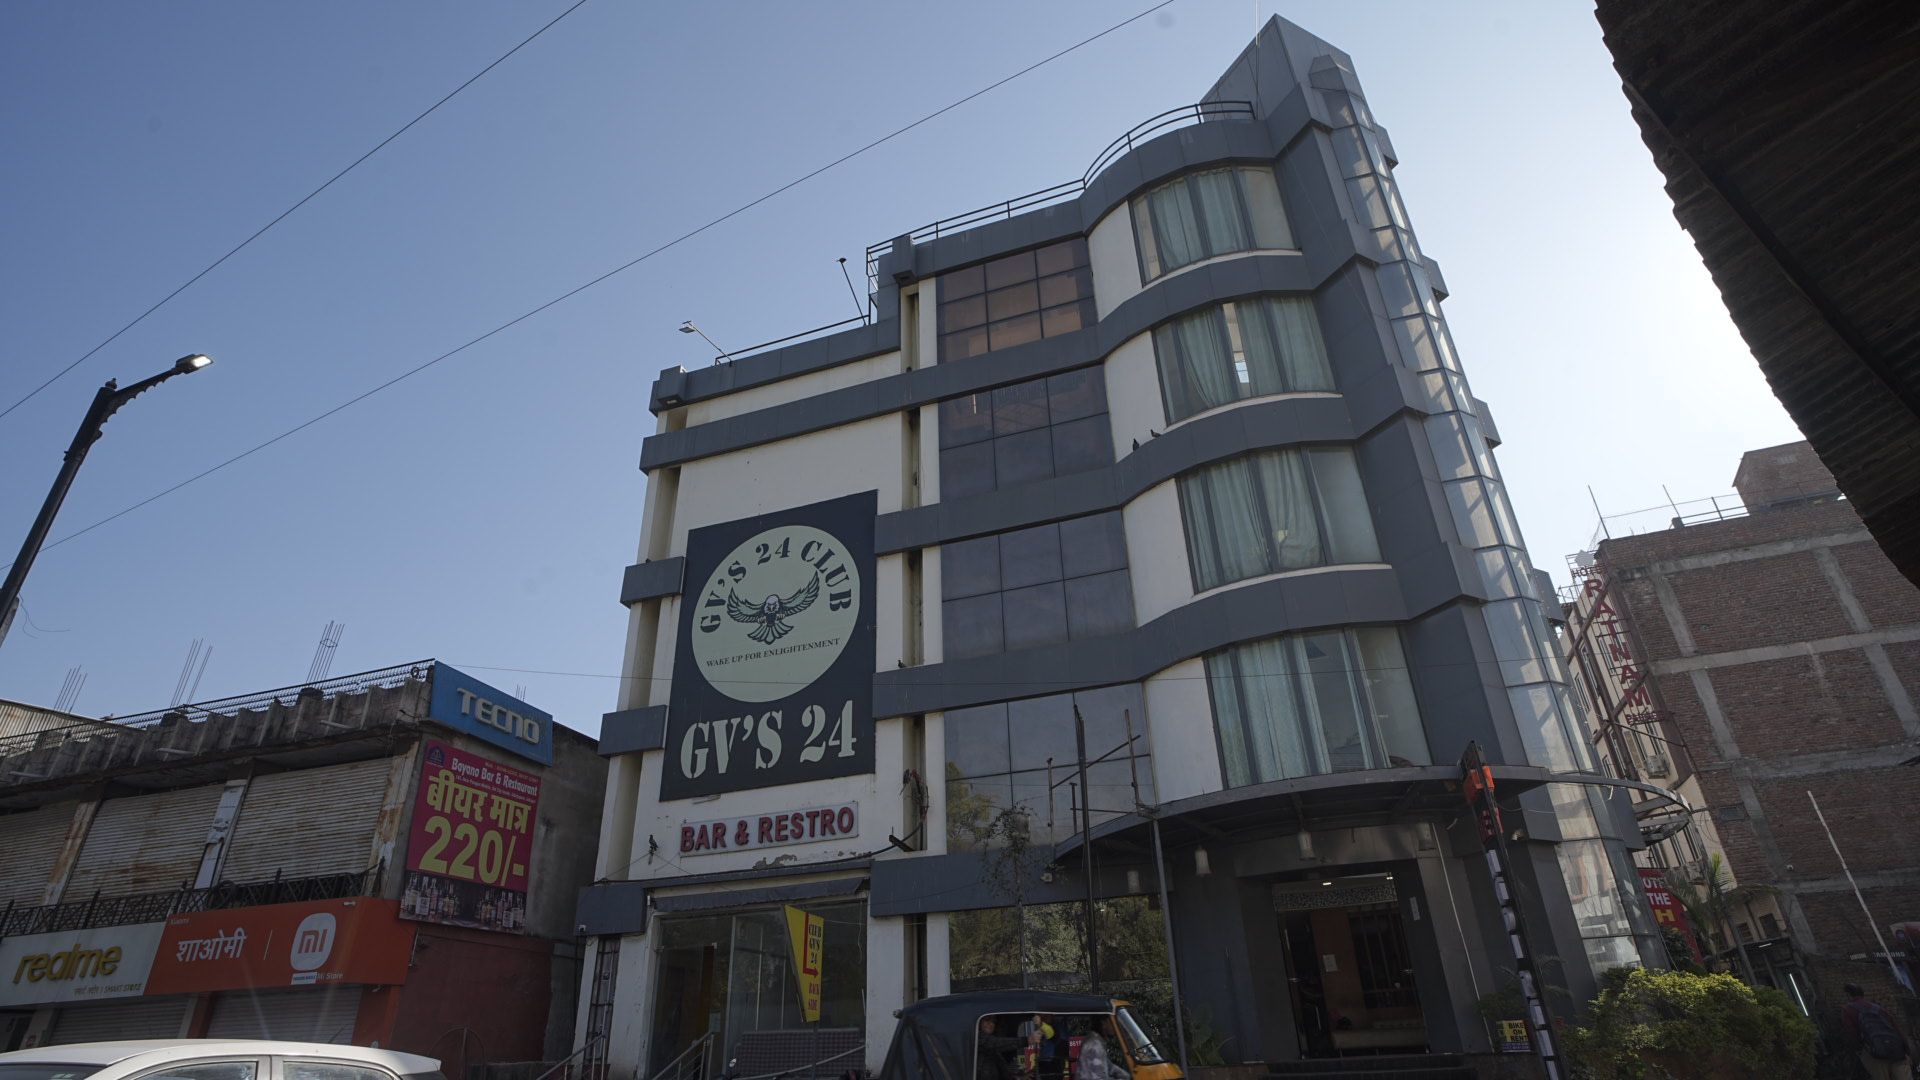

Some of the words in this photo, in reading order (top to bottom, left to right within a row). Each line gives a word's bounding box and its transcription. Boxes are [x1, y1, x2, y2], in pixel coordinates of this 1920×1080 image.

[700, 560, 747, 633] GV'S
[755, 537, 790, 565] 24
[801, 541, 852, 612] CLUB
[706, 657, 731, 667] WAKE
[731, 655, 744, 664] UP
[745, 652, 762, 662] FOR
[763, 638, 840, 657] ENLIGHTENMENT
[1584, 579, 1651, 708] RATNAM
[457, 688, 540, 744] TECNO
[680, 710, 783, 779] GV'S
[800, 700, 857, 763] 24
[427, 769, 488, 822] बीयर
[490, 795, 532, 834] मात्र
[481, 768, 495, 783] Bar
[495, 772, 502, 785] &
[503, 775, 538, 796] Restaurant
[419, 816, 525, 887] 220/-
[680, 822, 727, 852] BAR
[735, 820, 749, 846] &
[758, 806, 854, 844] RESTRO
[1646, 892, 1672, 905] THE
[13, 944, 122, 984] realme
[176, 928, 247, 962] शाओमी
